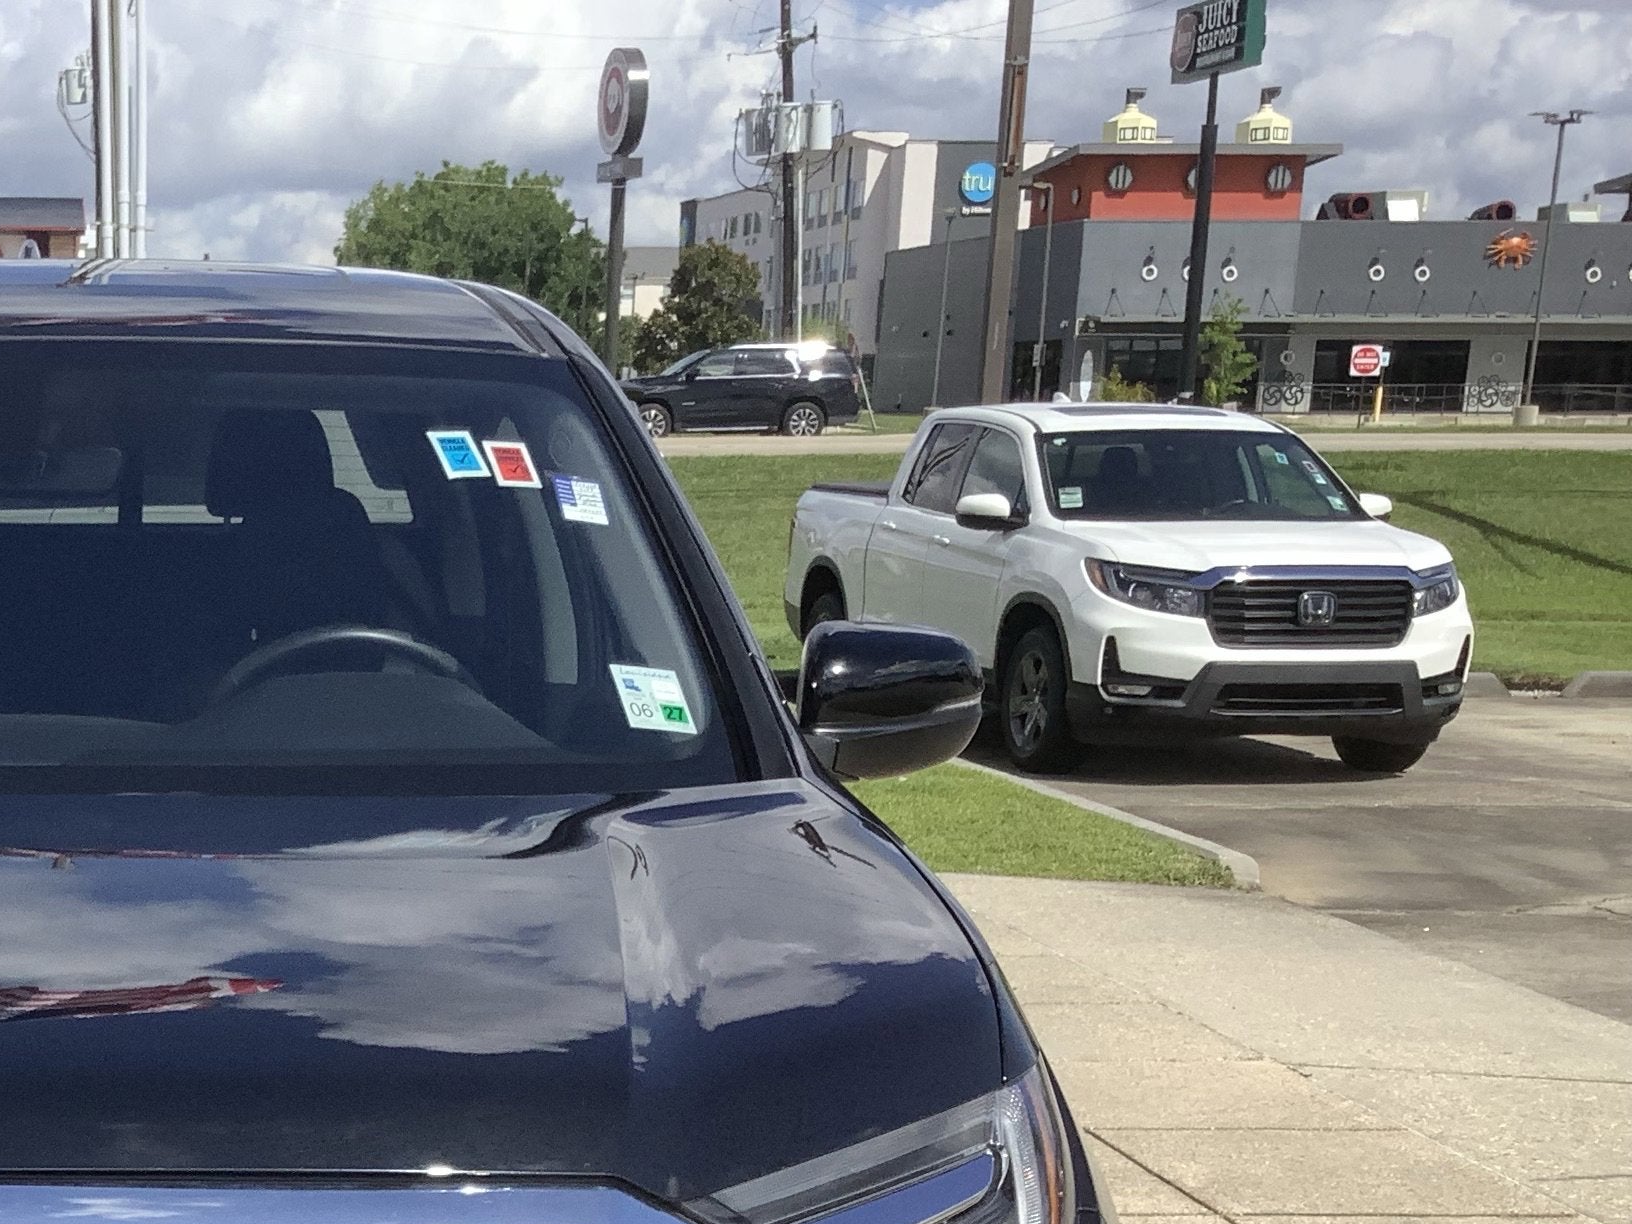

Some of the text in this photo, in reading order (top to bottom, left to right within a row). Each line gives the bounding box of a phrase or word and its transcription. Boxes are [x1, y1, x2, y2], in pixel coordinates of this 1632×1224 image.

[1198, 0, 1240, 33] JUICY
[1196, 24, 1238, 53] SEAFOOD
[962, 171, 992, 191] tru
[630, 702, 683, 721] 06 27
